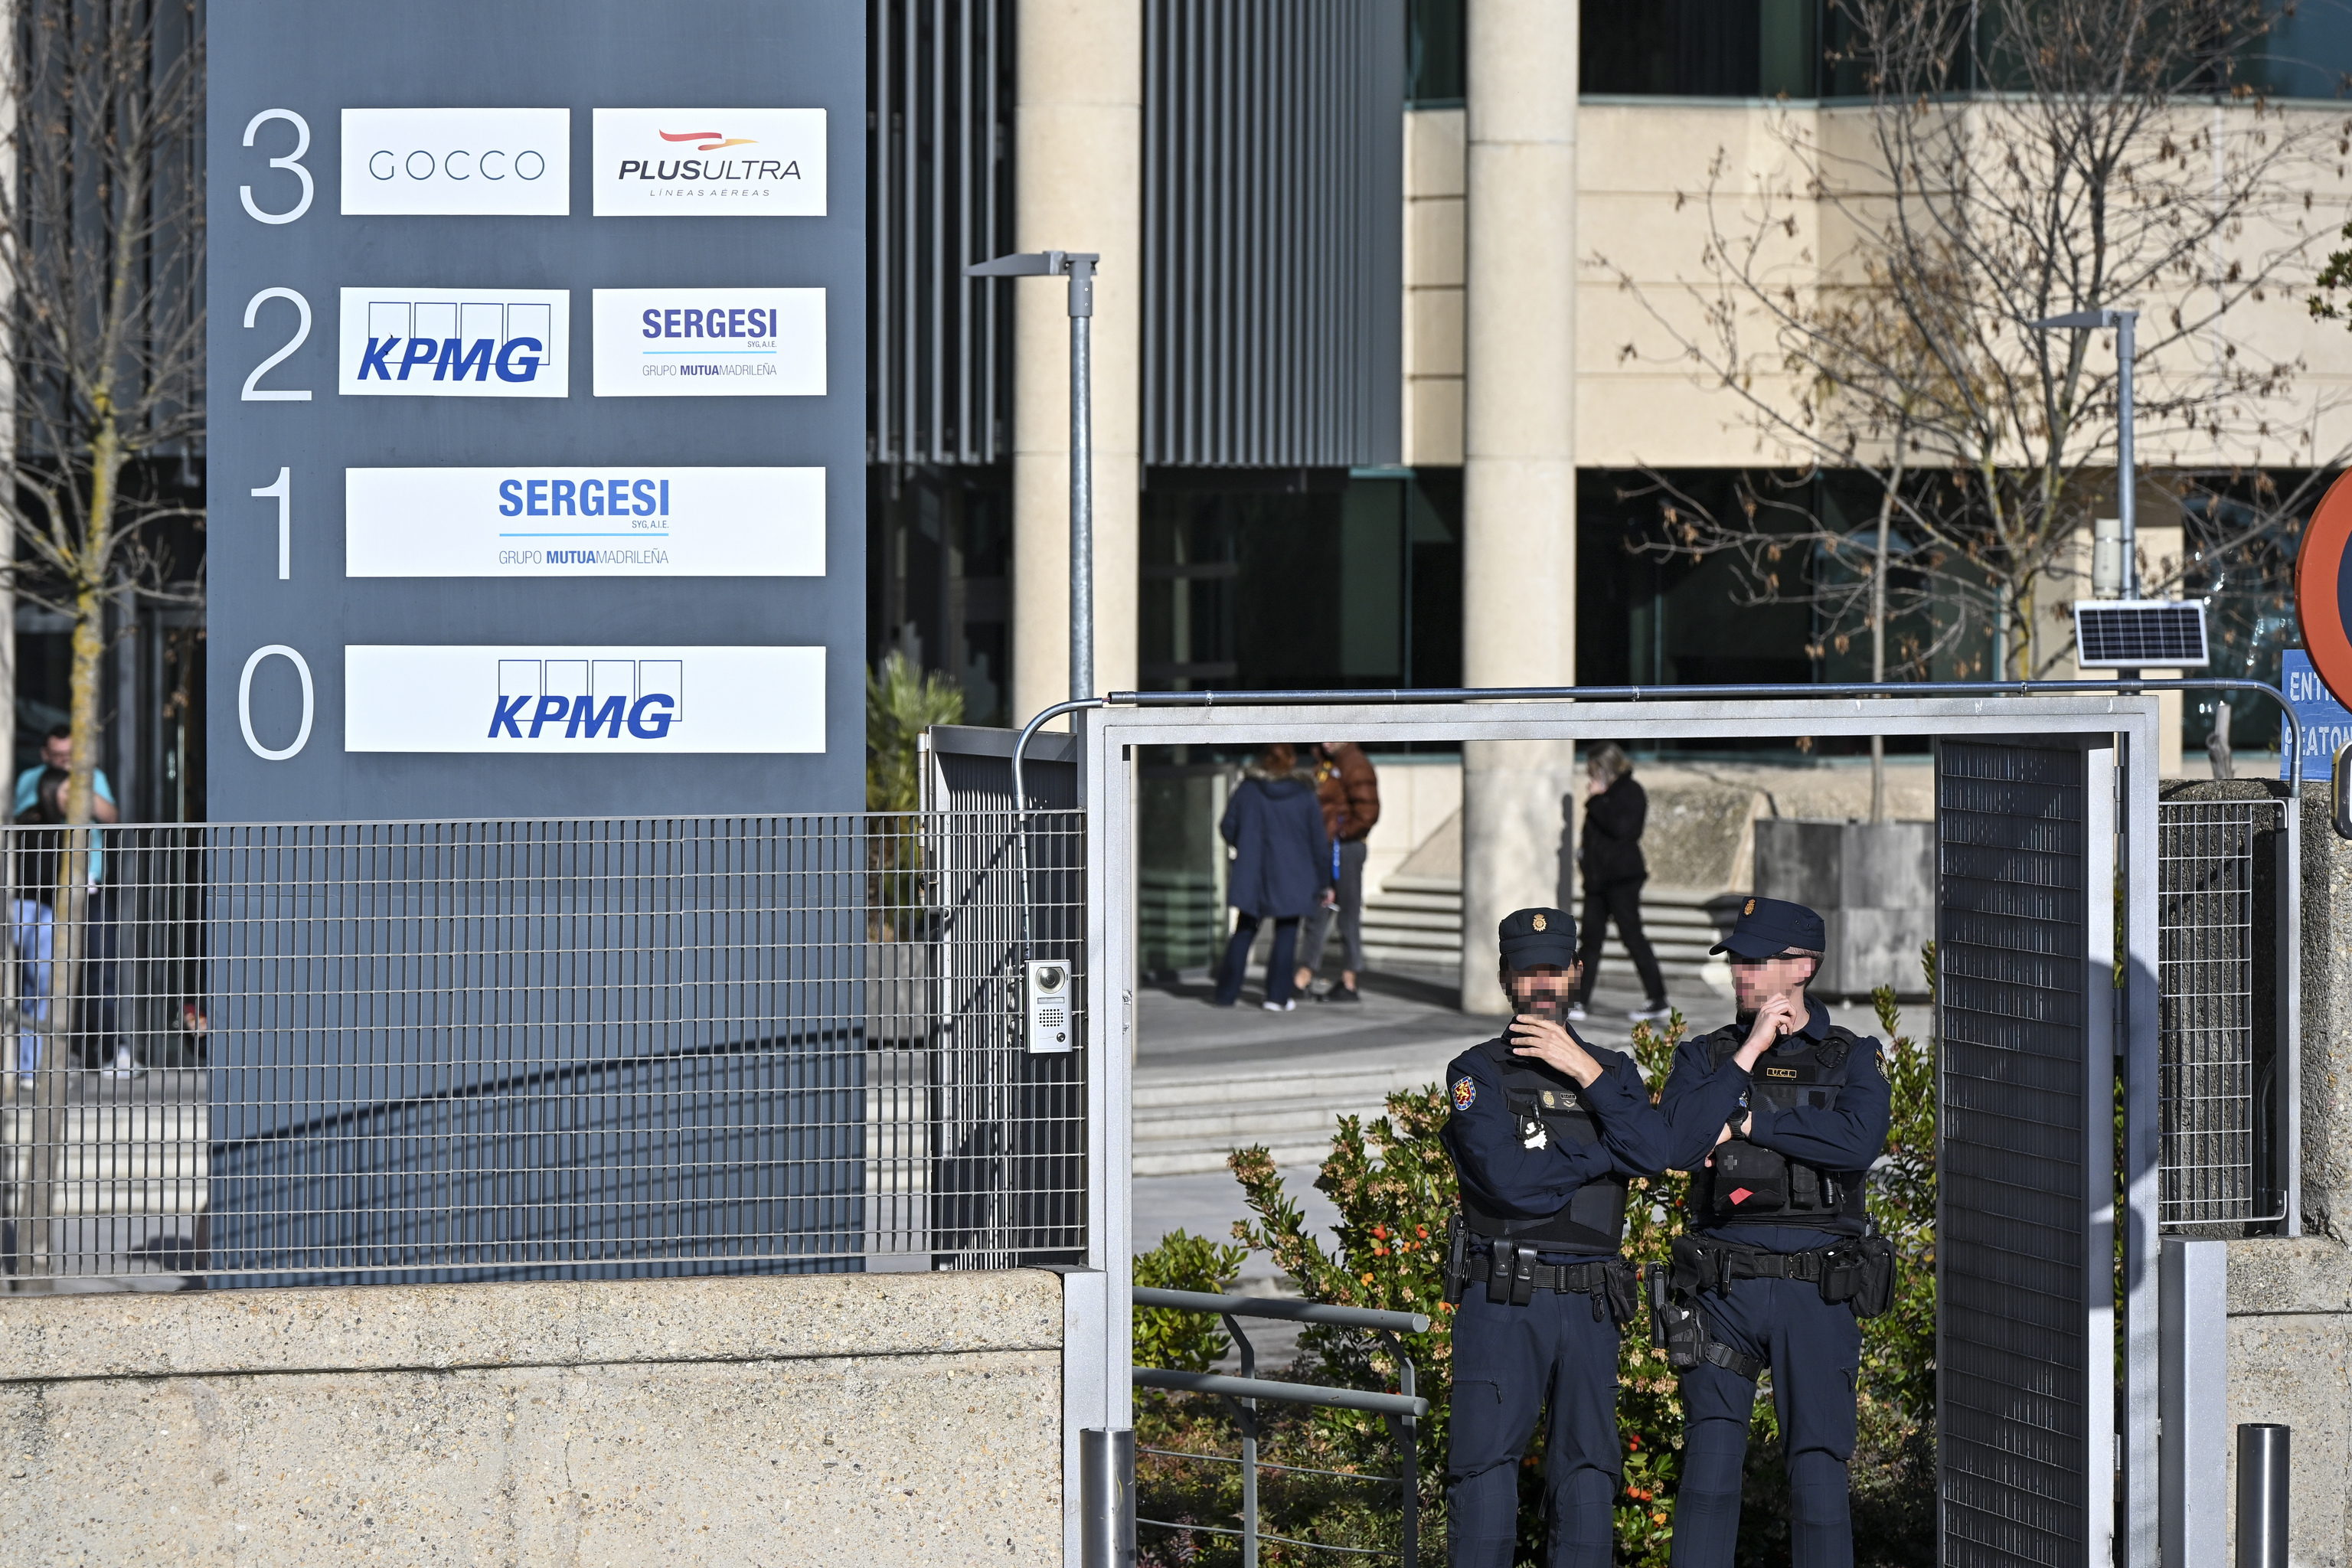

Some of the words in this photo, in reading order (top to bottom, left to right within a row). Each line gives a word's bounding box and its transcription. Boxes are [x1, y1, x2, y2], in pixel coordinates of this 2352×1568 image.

[240, 108, 314, 225] 3
[368, 149, 545, 181] GOCCO
[618, 159, 802, 181] PLUSULTRA
[649, 188, 704, 197] LÍNEAS
[709, 188, 770, 197] AÉREAS
[642, 308, 777, 338] SERGESI
[240, 286, 312, 401] 2
[358, 337, 544, 384] KPMG
[642, 364, 677, 376] GRUPO
[680, 362, 777, 376] MUTUAMADRILEÑA
[498, 479, 669, 517] SERGESI
[250, 466, 290, 580] 1
[632, 520, 649, 530] SYG,
[650, 520, 669, 528] A.I.E.
[498, 550, 542, 564] GRUPO
[546, 547, 669, 564] MUTUAMADRILEÑA
[238, 644, 314, 761] 0
[488, 693, 675, 740] KPMG
[2284, 726, 2352, 756] PATO
